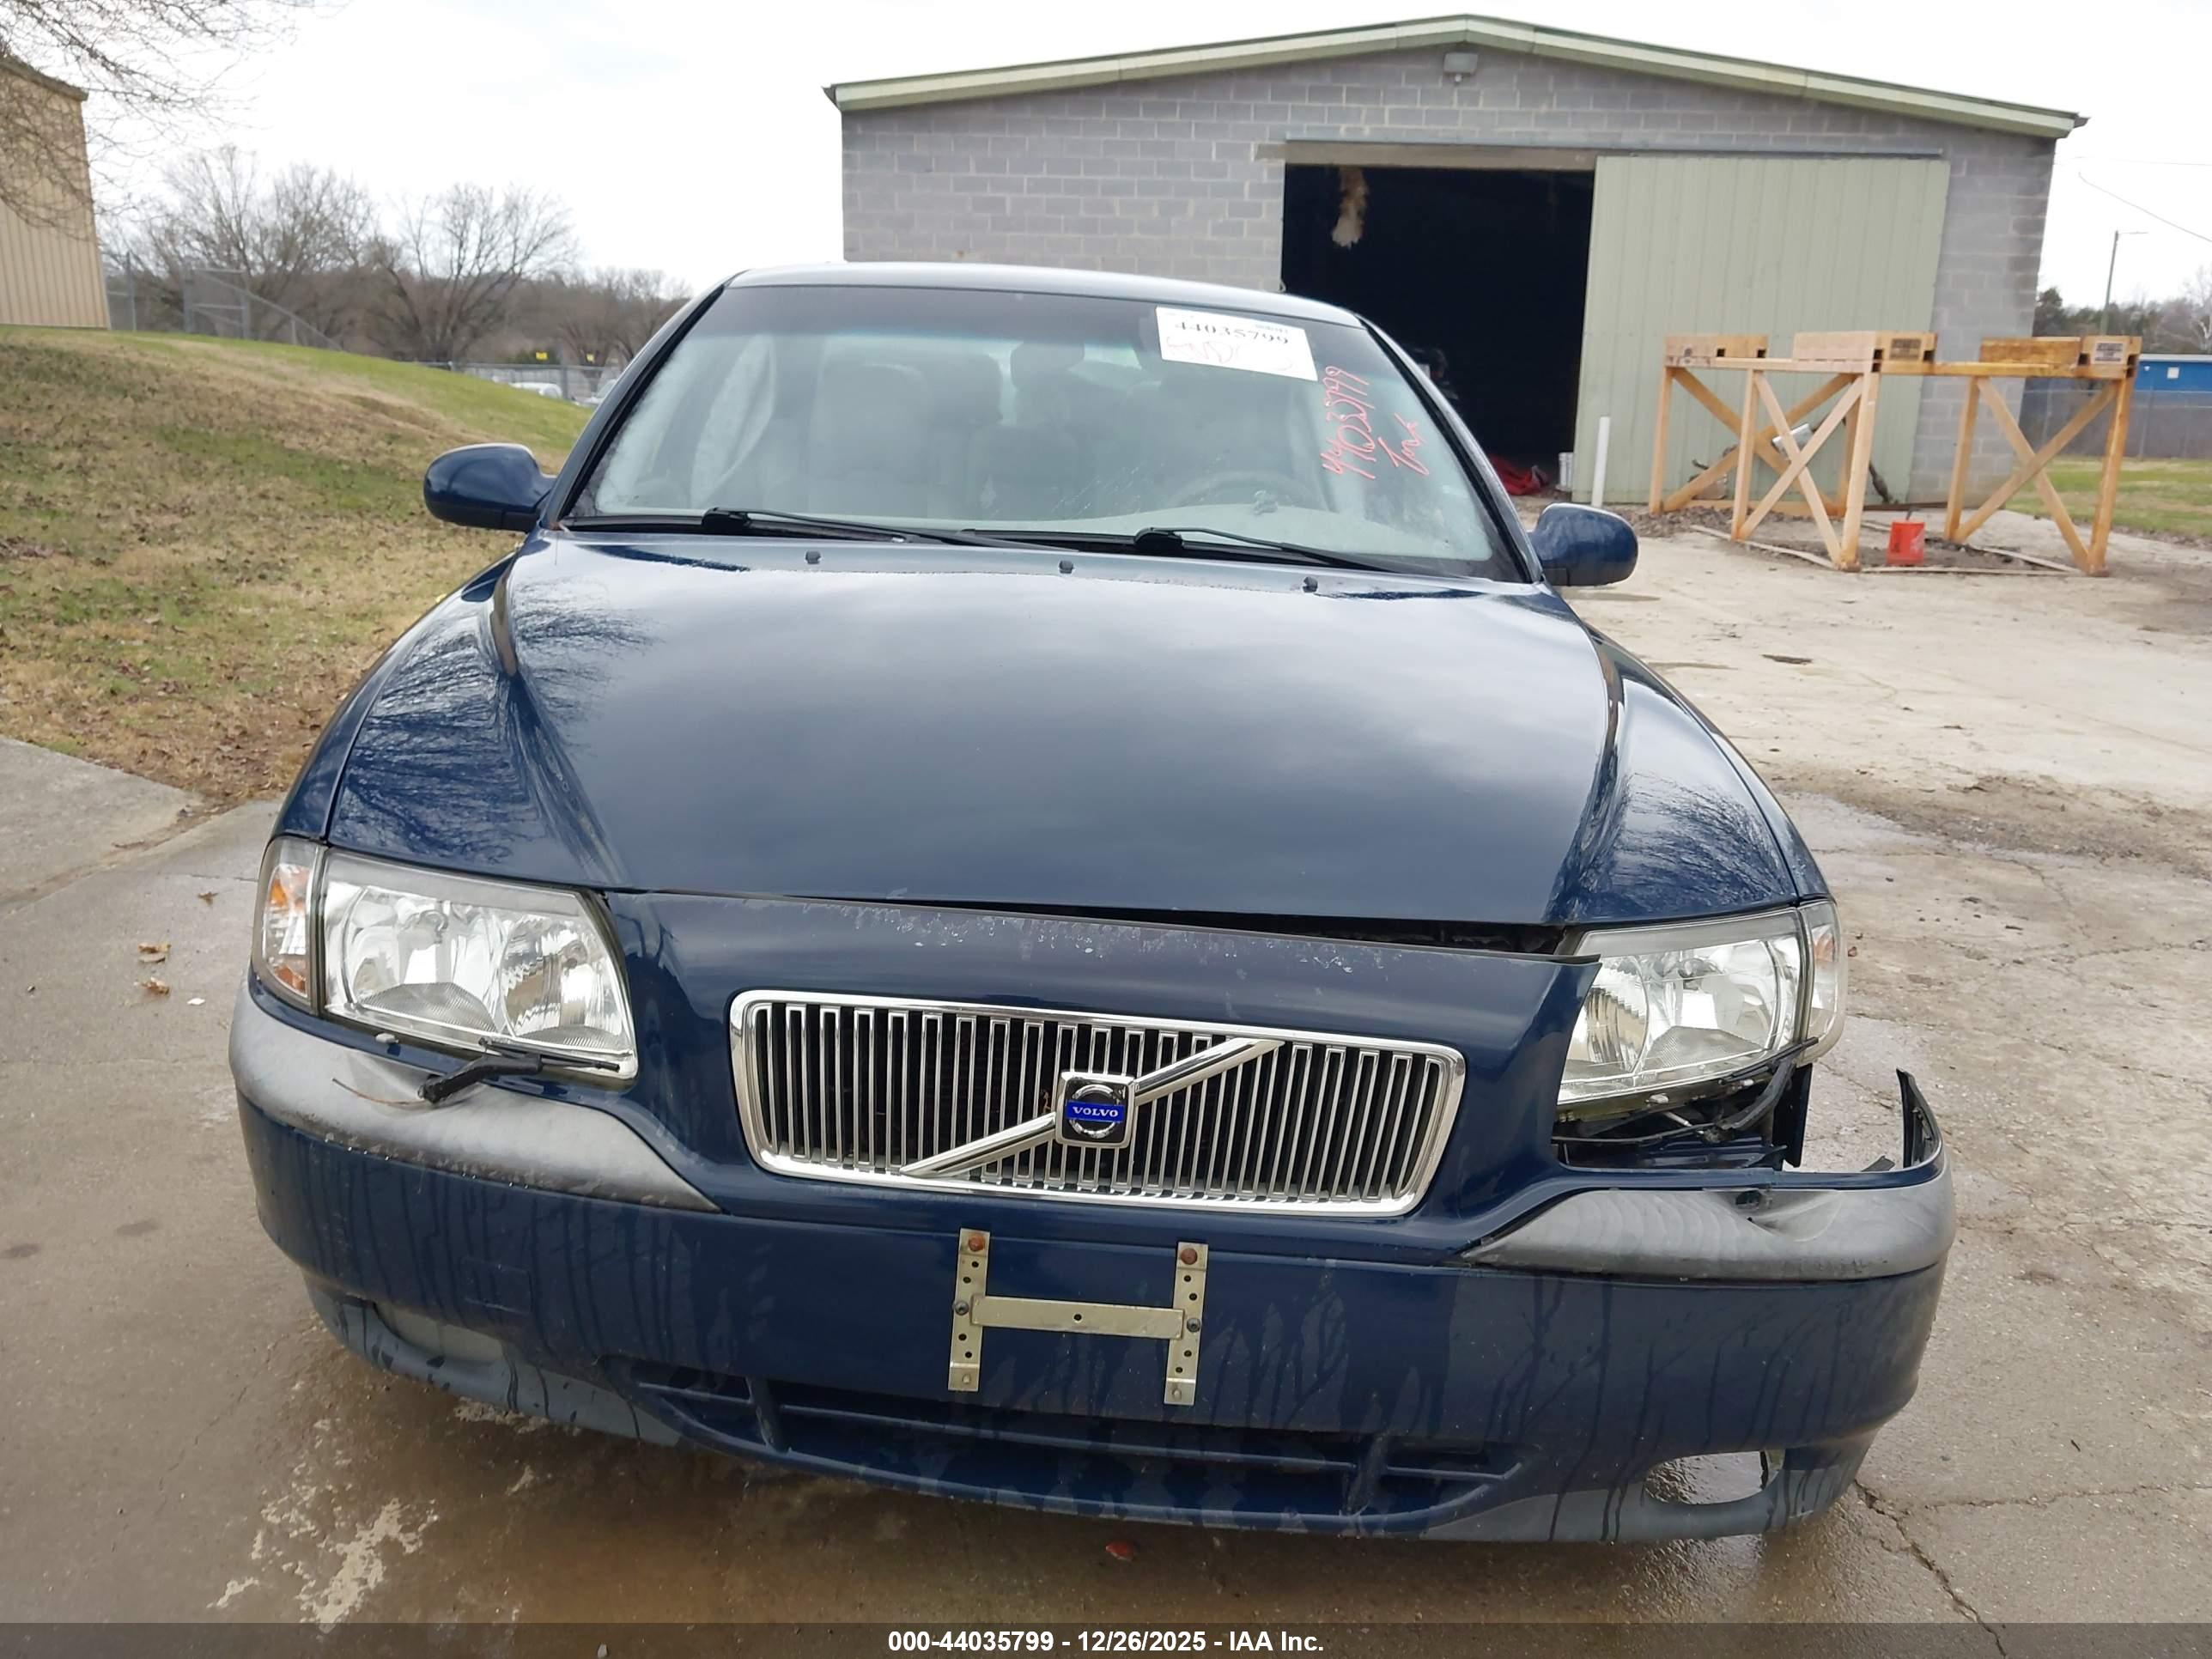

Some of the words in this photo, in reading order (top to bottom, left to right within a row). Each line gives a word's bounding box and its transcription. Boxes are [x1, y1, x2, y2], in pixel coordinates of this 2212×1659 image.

[1174, 320, 1289, 344] 44035799
[1320, 367, 1376, 479] 44035799
[1073, 1106, 1119, 1118] VOLVO
